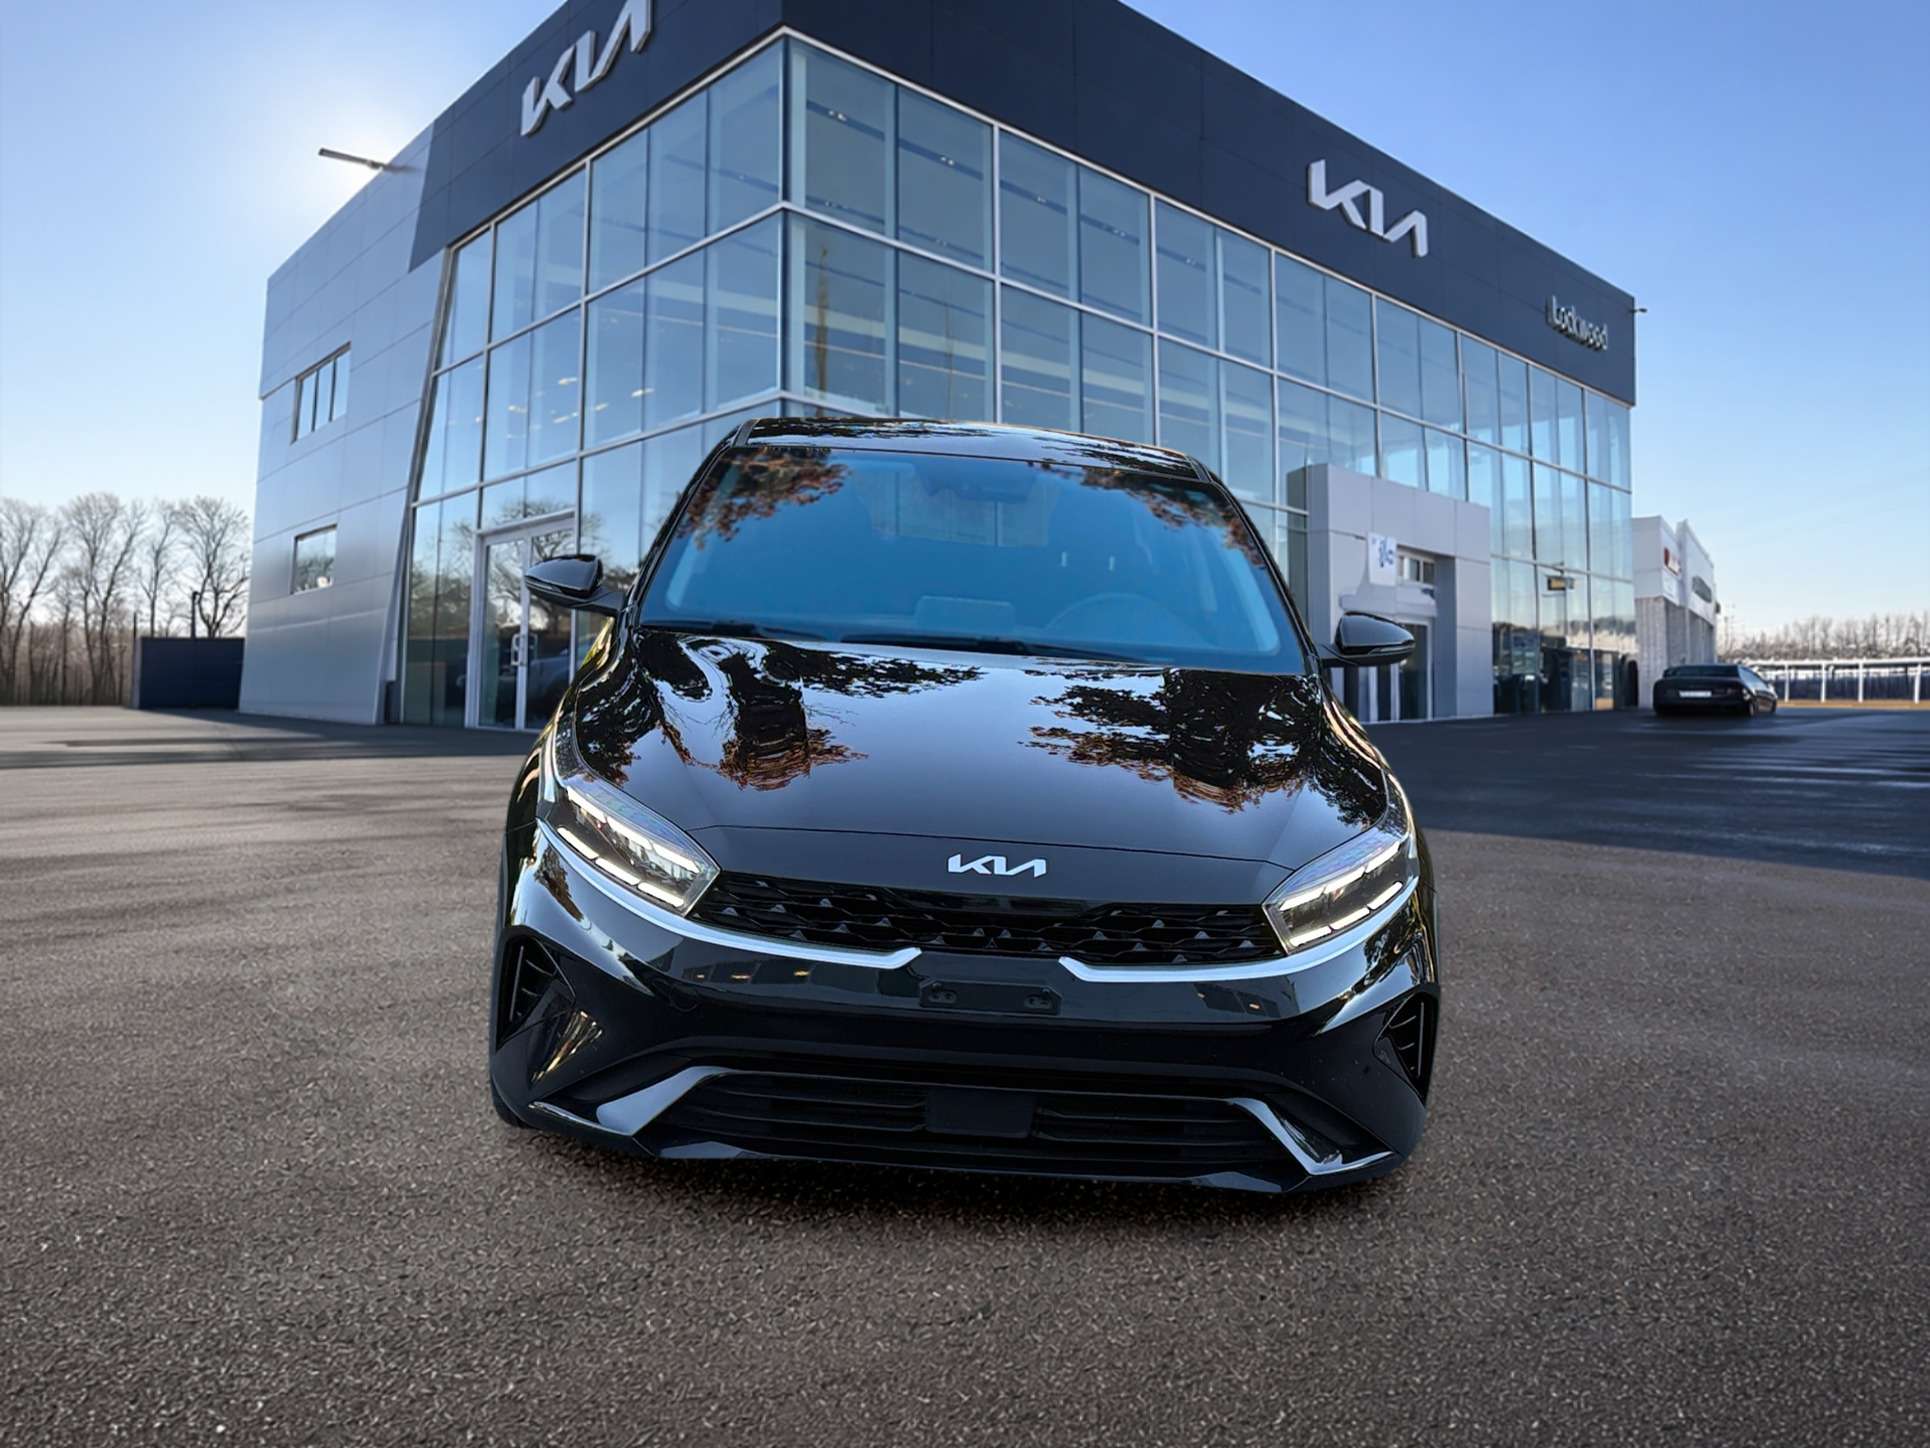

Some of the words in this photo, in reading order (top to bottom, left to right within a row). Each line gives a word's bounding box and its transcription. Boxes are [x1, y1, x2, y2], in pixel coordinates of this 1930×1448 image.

[520, 0, 651, 137] KIA
[1308, 159, 1428, 258] KIA
[1549, 295, 1608, 351] Lockwood
[948, 853, 1046, 878] KIA
